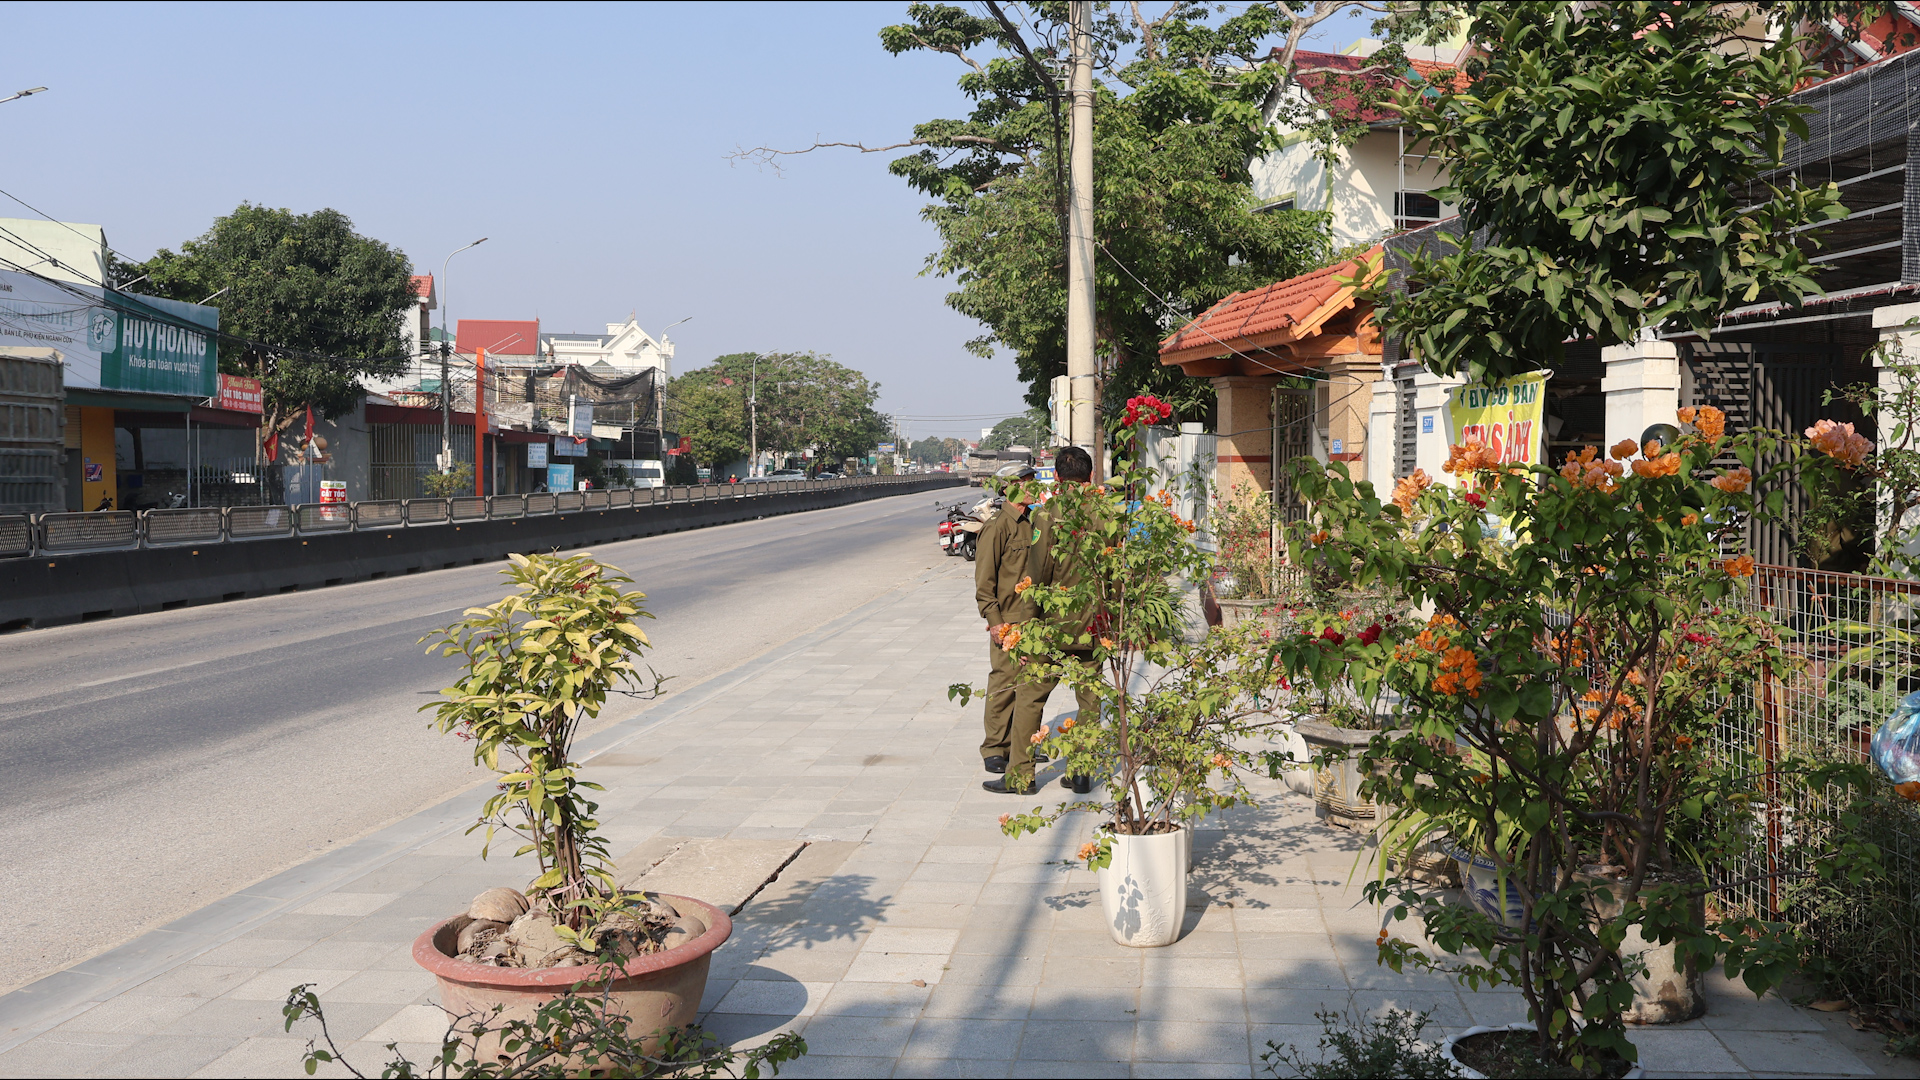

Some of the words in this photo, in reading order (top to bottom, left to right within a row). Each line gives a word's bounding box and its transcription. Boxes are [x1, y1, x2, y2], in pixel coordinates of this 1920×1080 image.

[122, 318, 207, 356] HUYHOANG
[129, 354, 147, 368] Khóa
[147, 359, 156, 369] an
[157, 358, 172, 370] toàn
[174, 360, 188, 375] vượt
[189, 362, 200, 376] trội
[553, 470, 570, 485] THỂ
